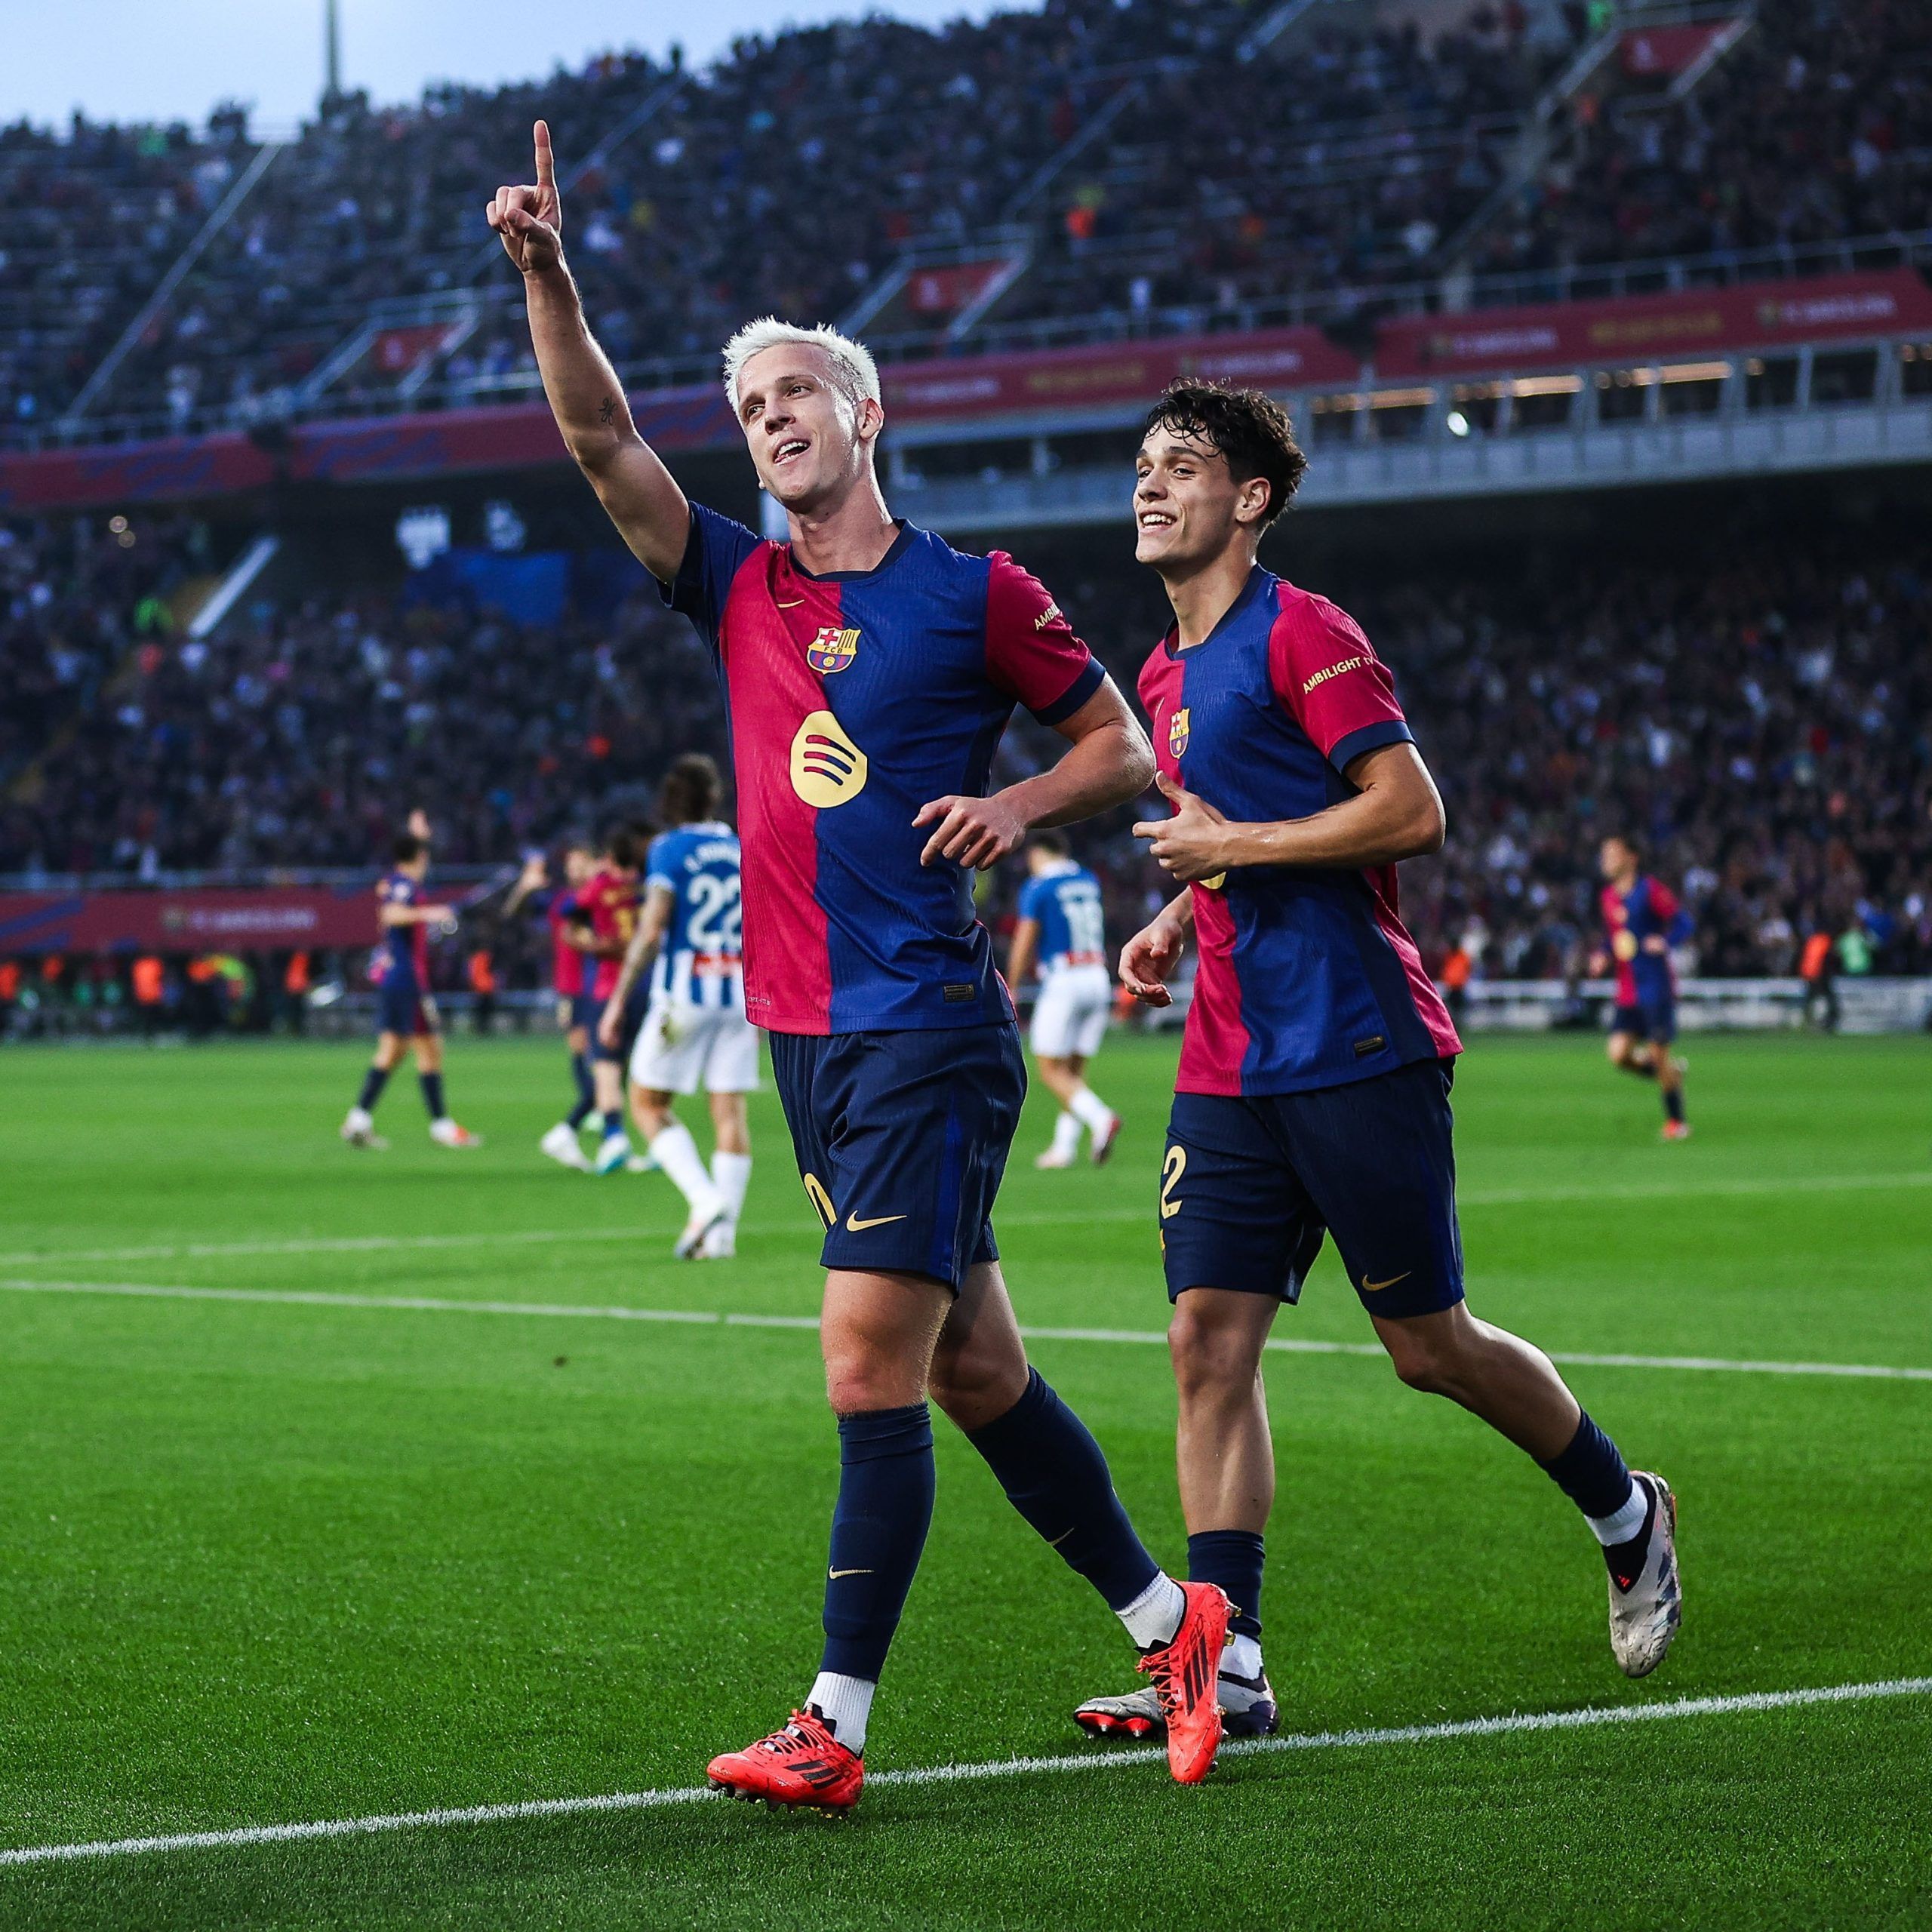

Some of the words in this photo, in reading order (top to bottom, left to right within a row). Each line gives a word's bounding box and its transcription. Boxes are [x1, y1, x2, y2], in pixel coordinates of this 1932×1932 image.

[823, 646, 843, 654] FCB
[1303, 657, 1361, 695] AMBILIGHT
[1161, 1145, 1186, 1220] 2
